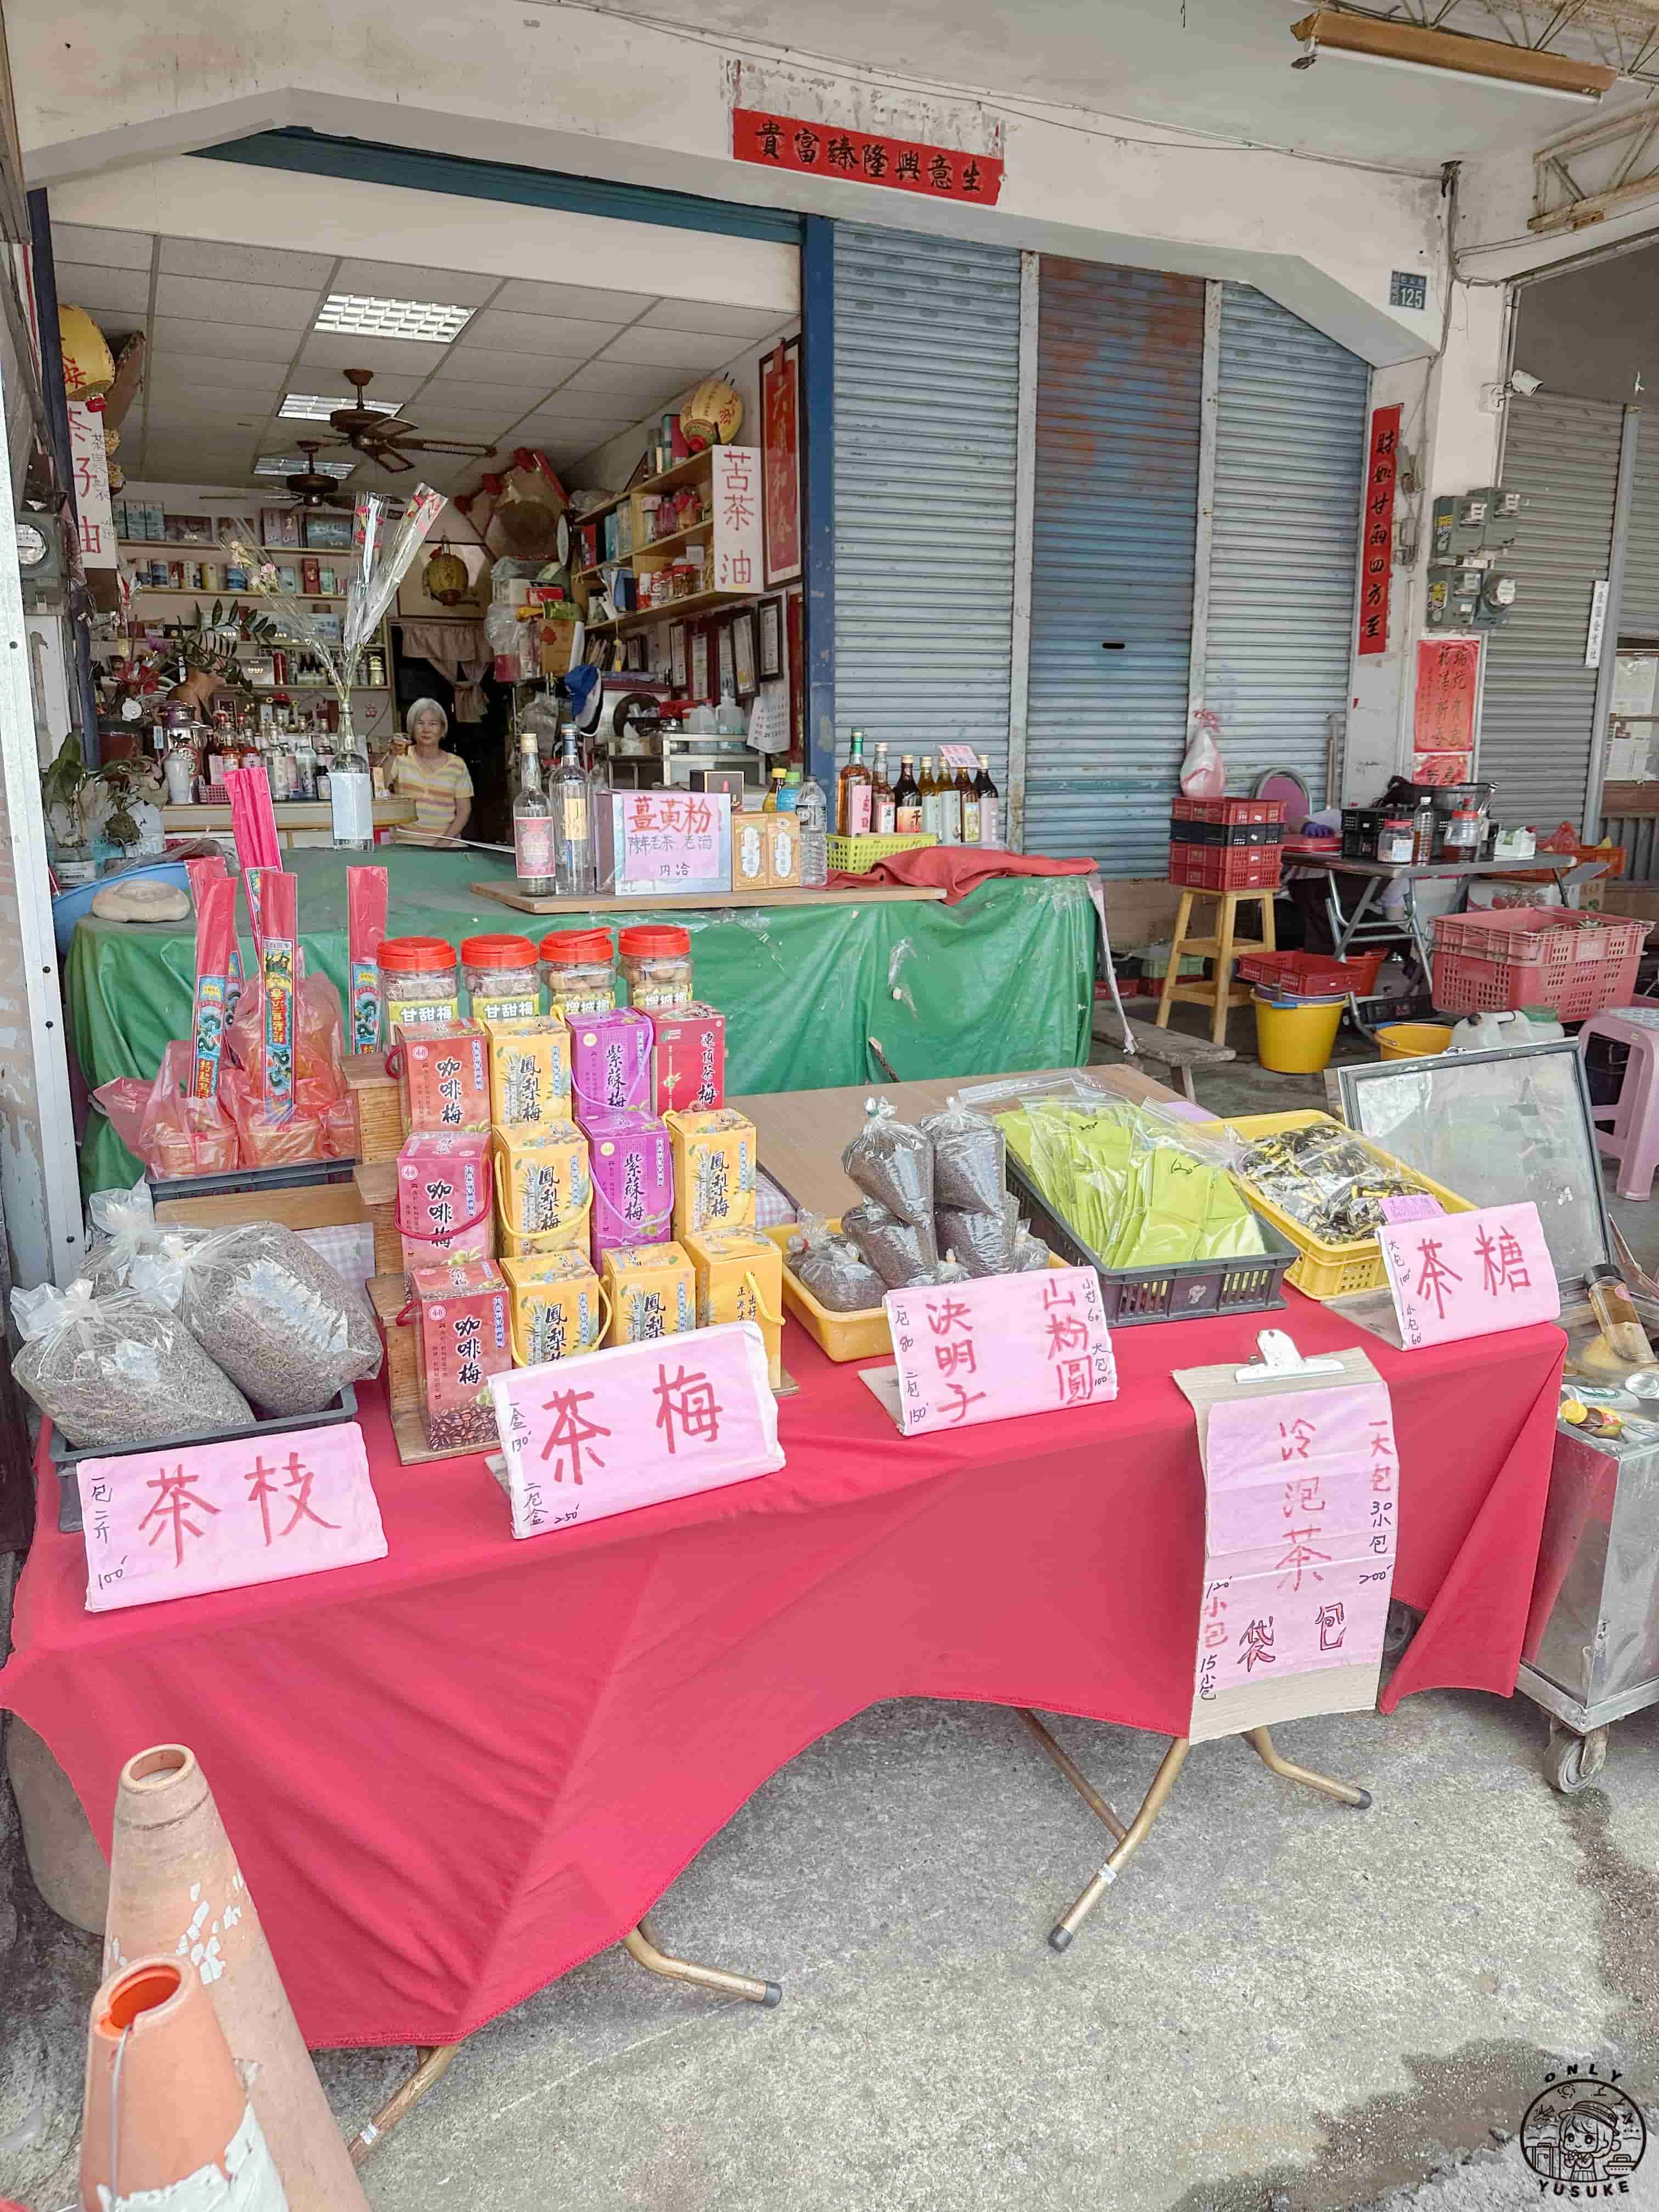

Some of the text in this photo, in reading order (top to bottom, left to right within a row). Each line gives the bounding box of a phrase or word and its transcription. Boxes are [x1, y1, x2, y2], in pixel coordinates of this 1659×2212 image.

[1401, 287, 1422, 308] 125
[720, 447, 754, 585] 苦茶油
[1365, 431, 1394, 638] 財如甘雨四方至
[400, 1005, 453, 1023] 甘甜梅
[485, 1001, 534, 1019] 甘甜梅
[436, 1057, 464, 1124] 咖啡梅
[521, 1054, 541, 1122] 鳳梨梅
[606, 1044, 627, 1108] 紫蘇梅
[426, 1180, 454, 1249] 咖啡梅
[538, 1166, 562, 1231] 鳳梨梅
[624, 1153, 645, 1221] 紫蘇梅
[710, 1150, 730, 1217] 鳳梨梅
[1389, 1240, 1405, 1267] 大包
[1417, 1224, 1532, 1319] 茶糖
[895, 1305, 910, 1327] 一包
[1044, 1278, 1093, 1404] 山粉圓
[1406, 1304, 1419, 1330] 小包
[454, 1315, 483, 1385] 咖啡梅
[1092, 1342, 1112, 1372] 大包
[905, 1372, 919, 1398] 二包
[541, 1363, 723, 1485] 茶梅
[138, 1452, 342, 1568] 茶枝
[1276, 1418, 1332, 1592] 冷泡茶
